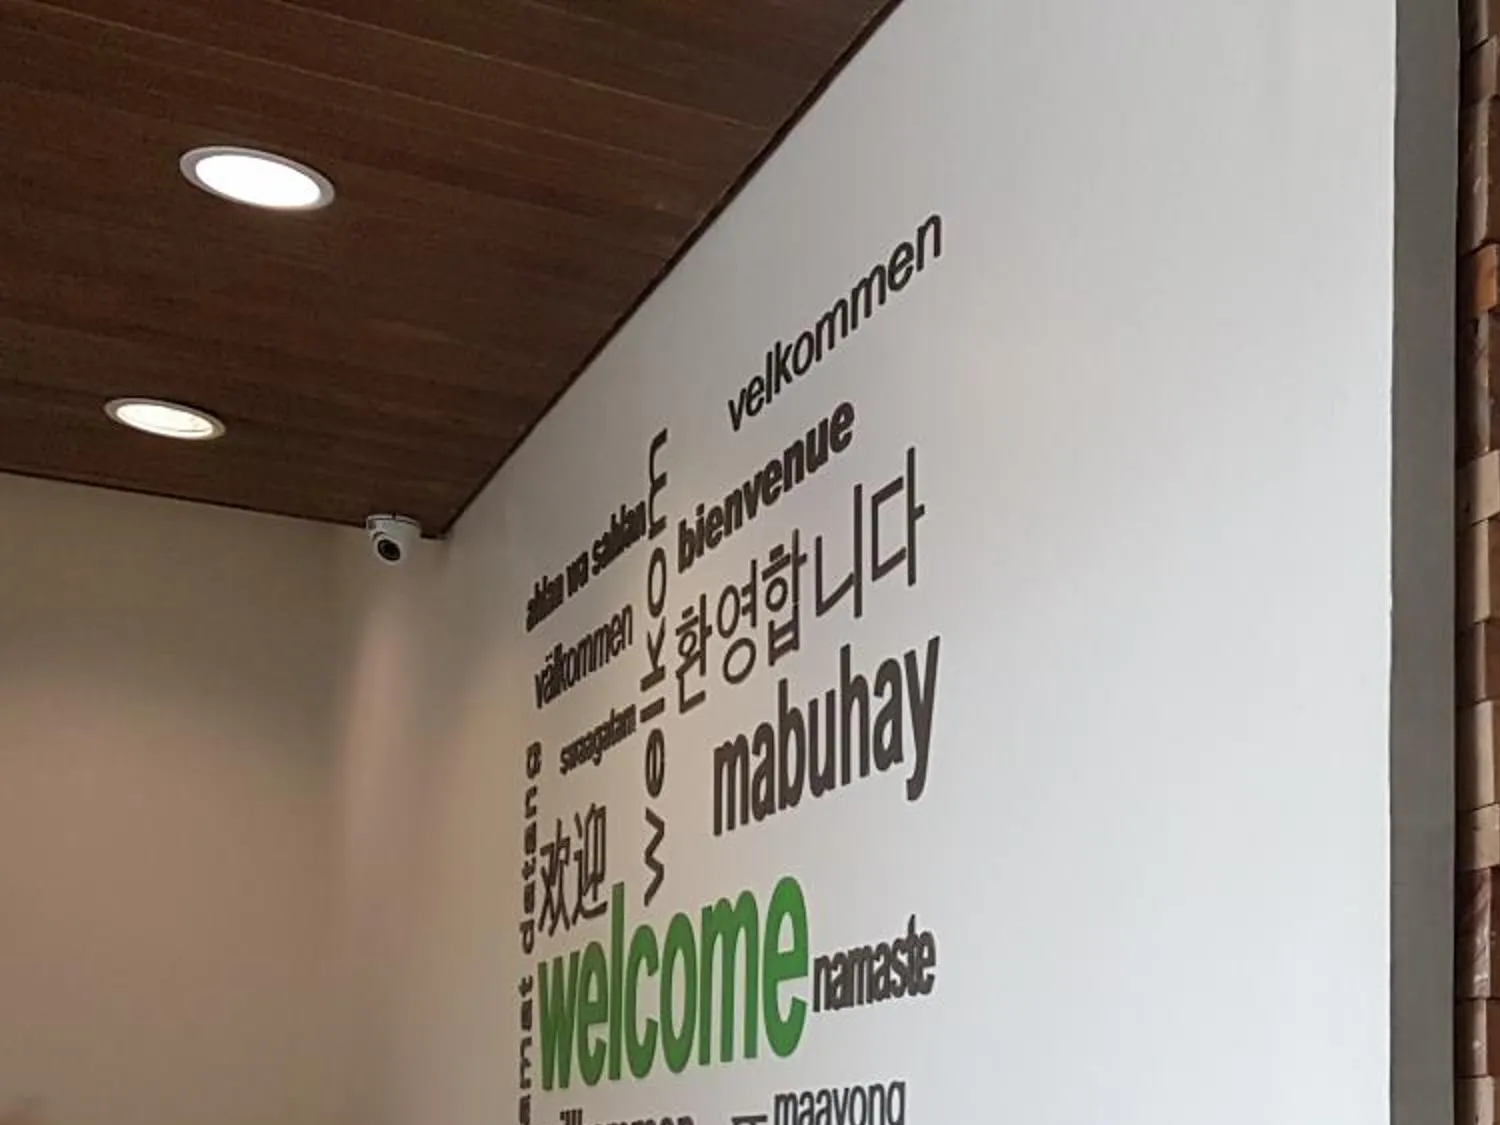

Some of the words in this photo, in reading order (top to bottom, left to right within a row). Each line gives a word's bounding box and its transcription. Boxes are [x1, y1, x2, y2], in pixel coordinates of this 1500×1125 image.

[728, 213, 942, 431] velkommen
[676, 447, 925, 713] 환영합니다
[677, 402, 855, 574] bienvenue
[640, 428, 667, 907] welkom
[713, 636, 940, 837] mabuhay
[538, 802, 608, 937] 欢迎
[812, 913, 936, 1012] namaste
[538, 876, 809, 1091] welcome
